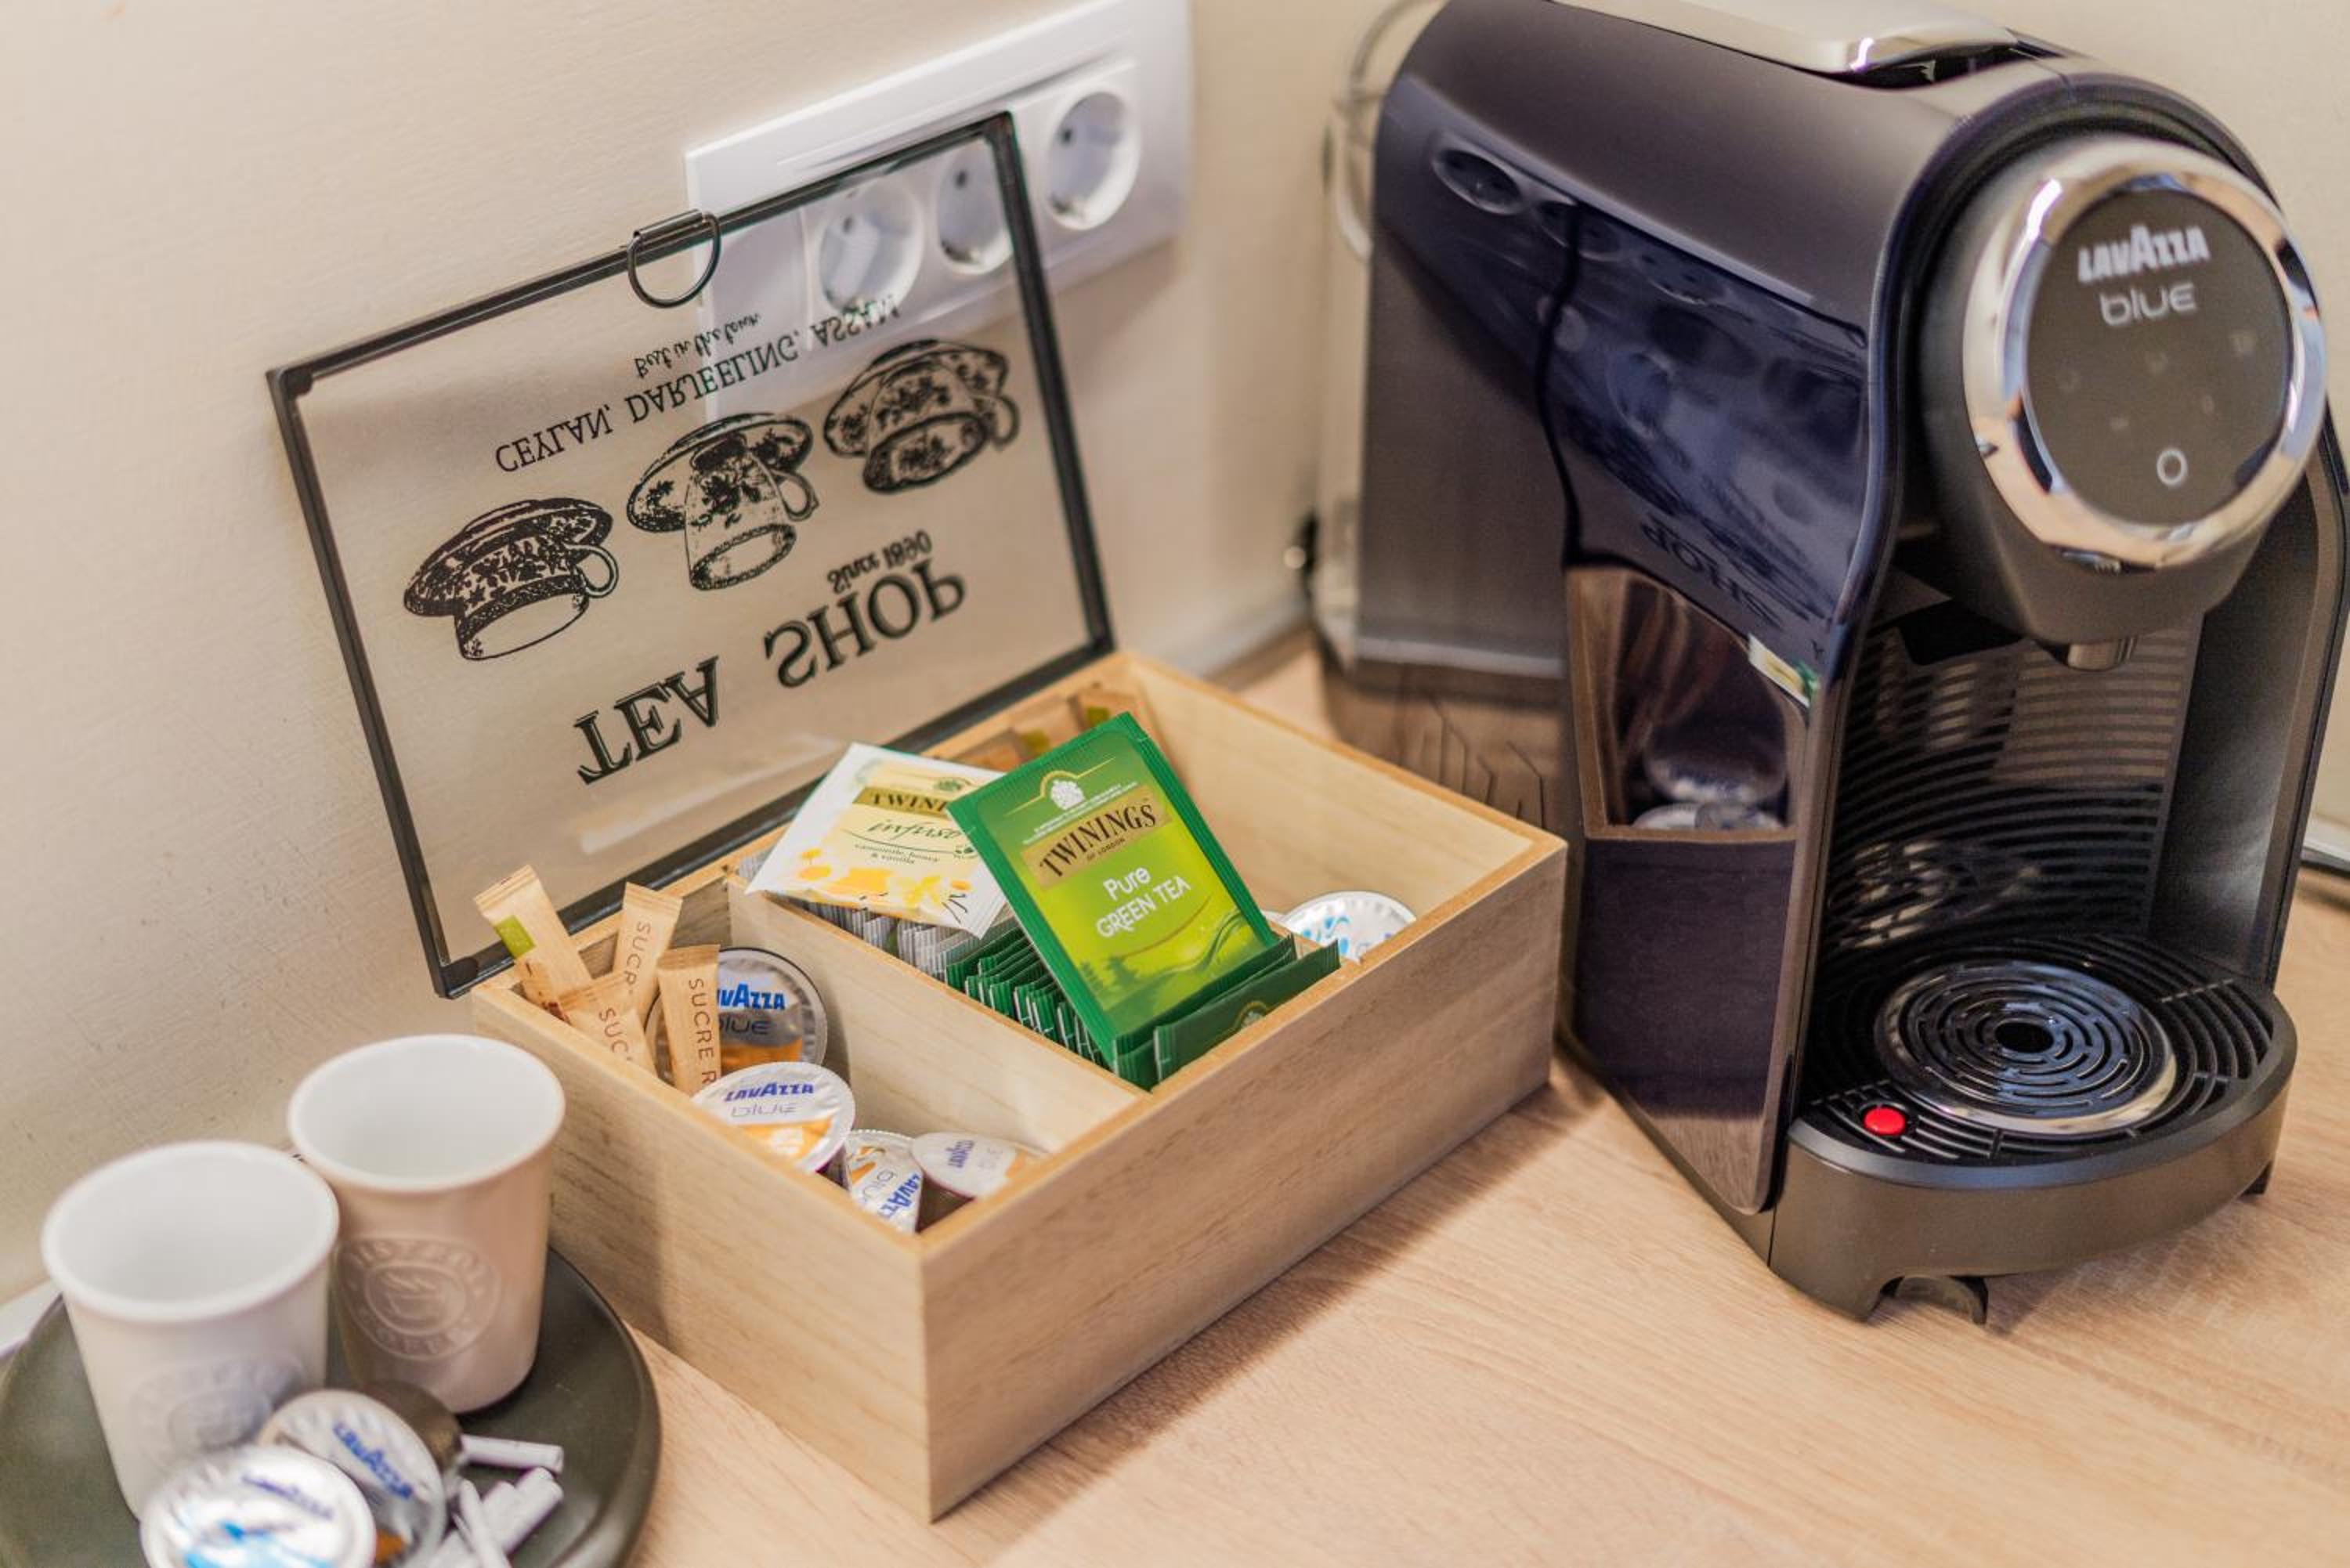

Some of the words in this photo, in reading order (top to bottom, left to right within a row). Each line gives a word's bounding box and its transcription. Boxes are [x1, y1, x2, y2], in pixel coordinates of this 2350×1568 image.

[2077, 224, 2211, 284] LAVAZZA
[870, 791, 948, 812] TWINI
[1039, 804, 1157, 878] TWININGS
[1096, 891, 1157, 938] GREEN
[1152, 874, 1191, 904] TEA
[1102, 866, 1152, 901] Pure
[624, 919, 653, 995] SUCR
[689, 978, 715, 1061] SUCRE
[716, 983, 786, 1011] VAZZA
[724, 1082, 814, 1102] LAVAZZA
